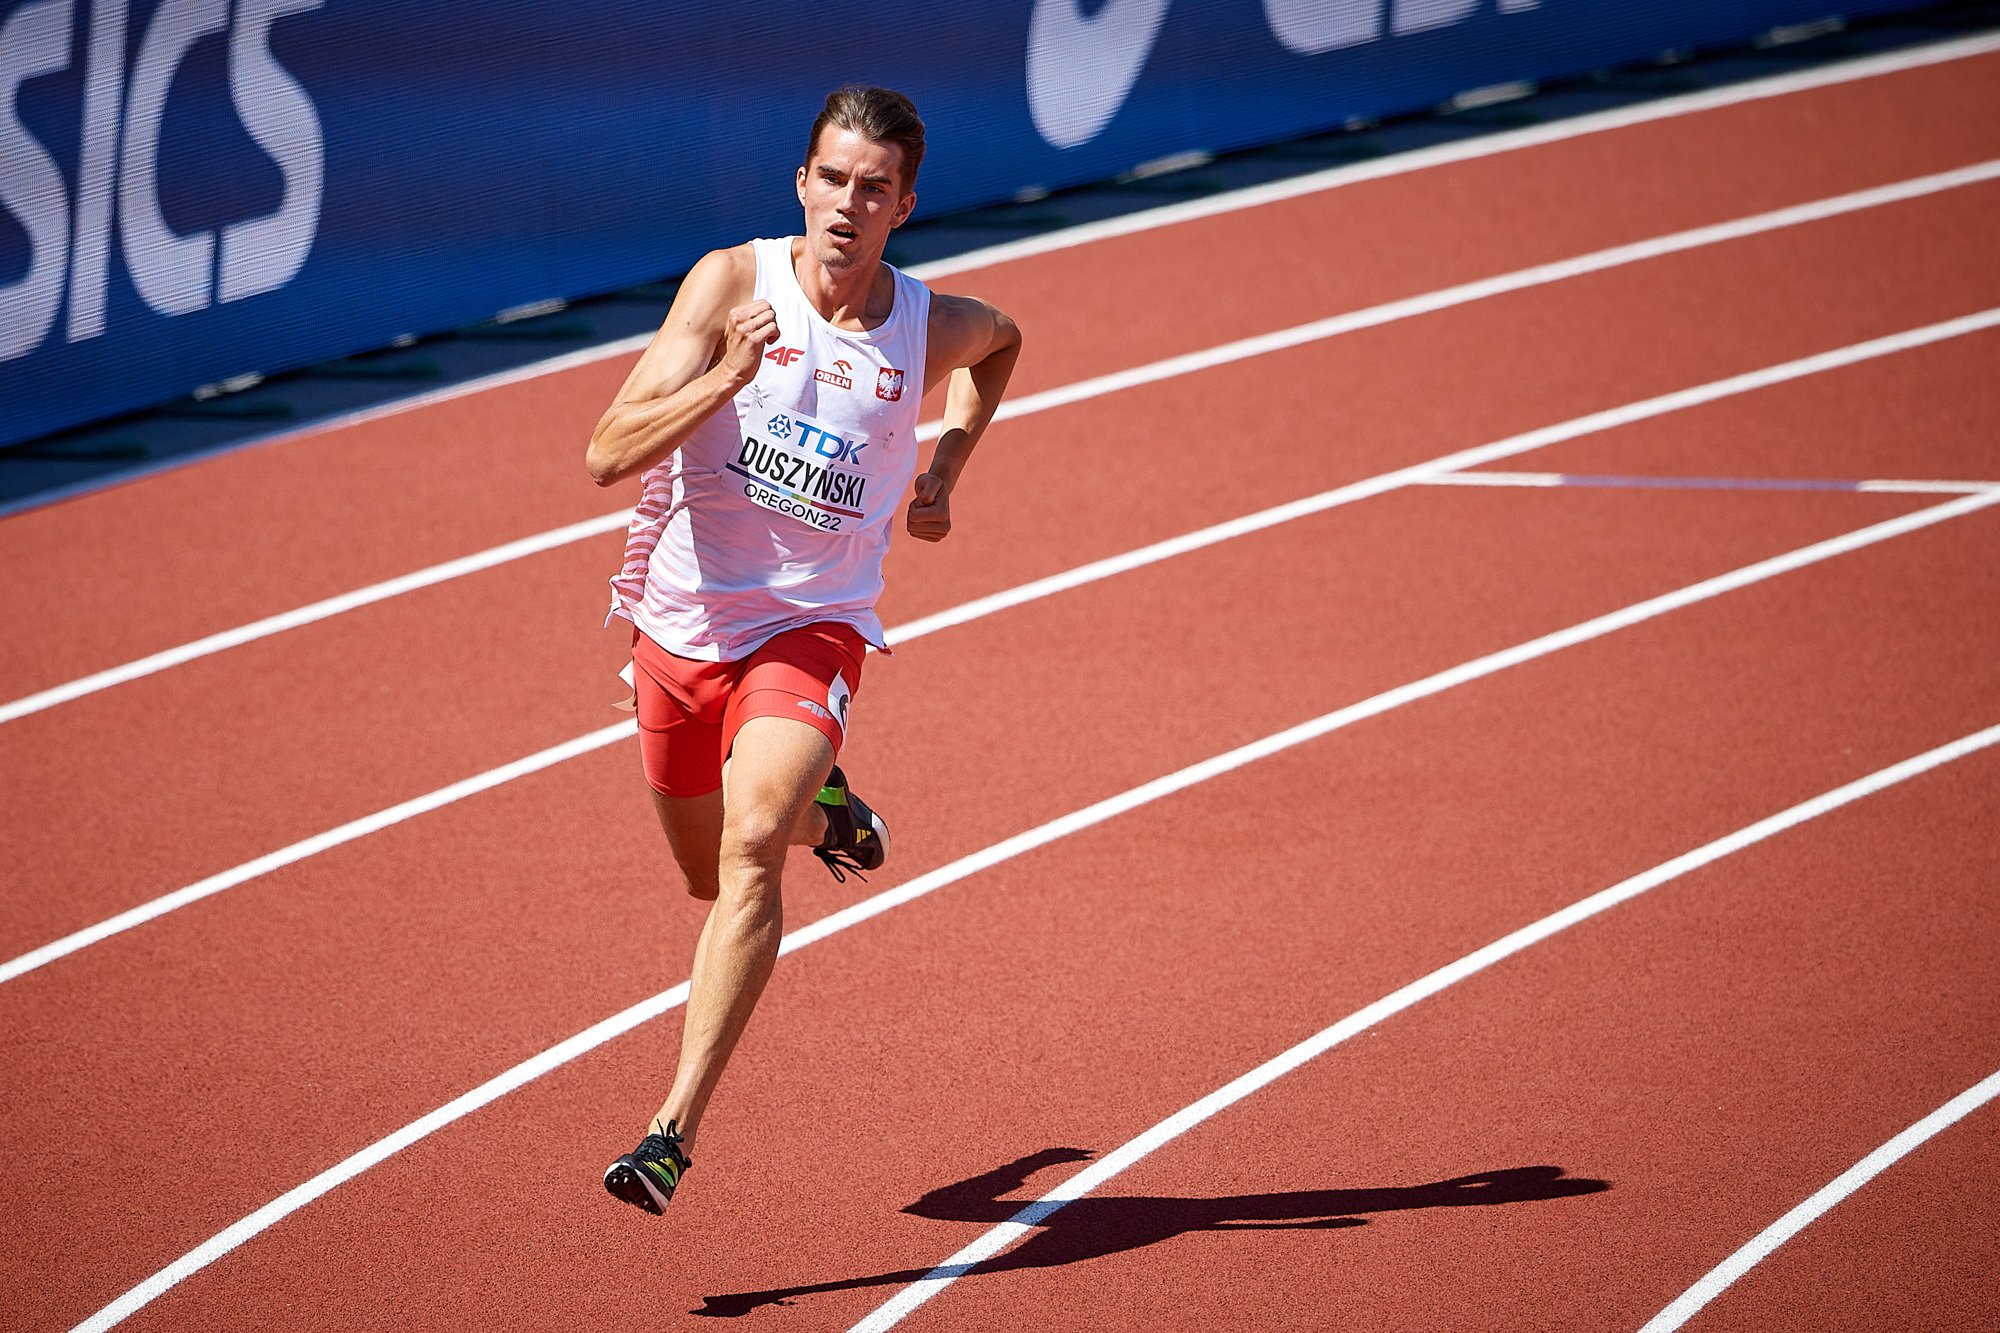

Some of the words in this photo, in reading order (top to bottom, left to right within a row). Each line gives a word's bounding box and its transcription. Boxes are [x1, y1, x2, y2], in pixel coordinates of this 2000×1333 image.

[765, 346, 805, 367] 4F
[815, 371, 851, 388] ORLEN
[794, 420, 869, 466] TDK
[738, 436, 866, 509] DUSZYŃSKI
[744, 483, 842, 532] OREGON22
